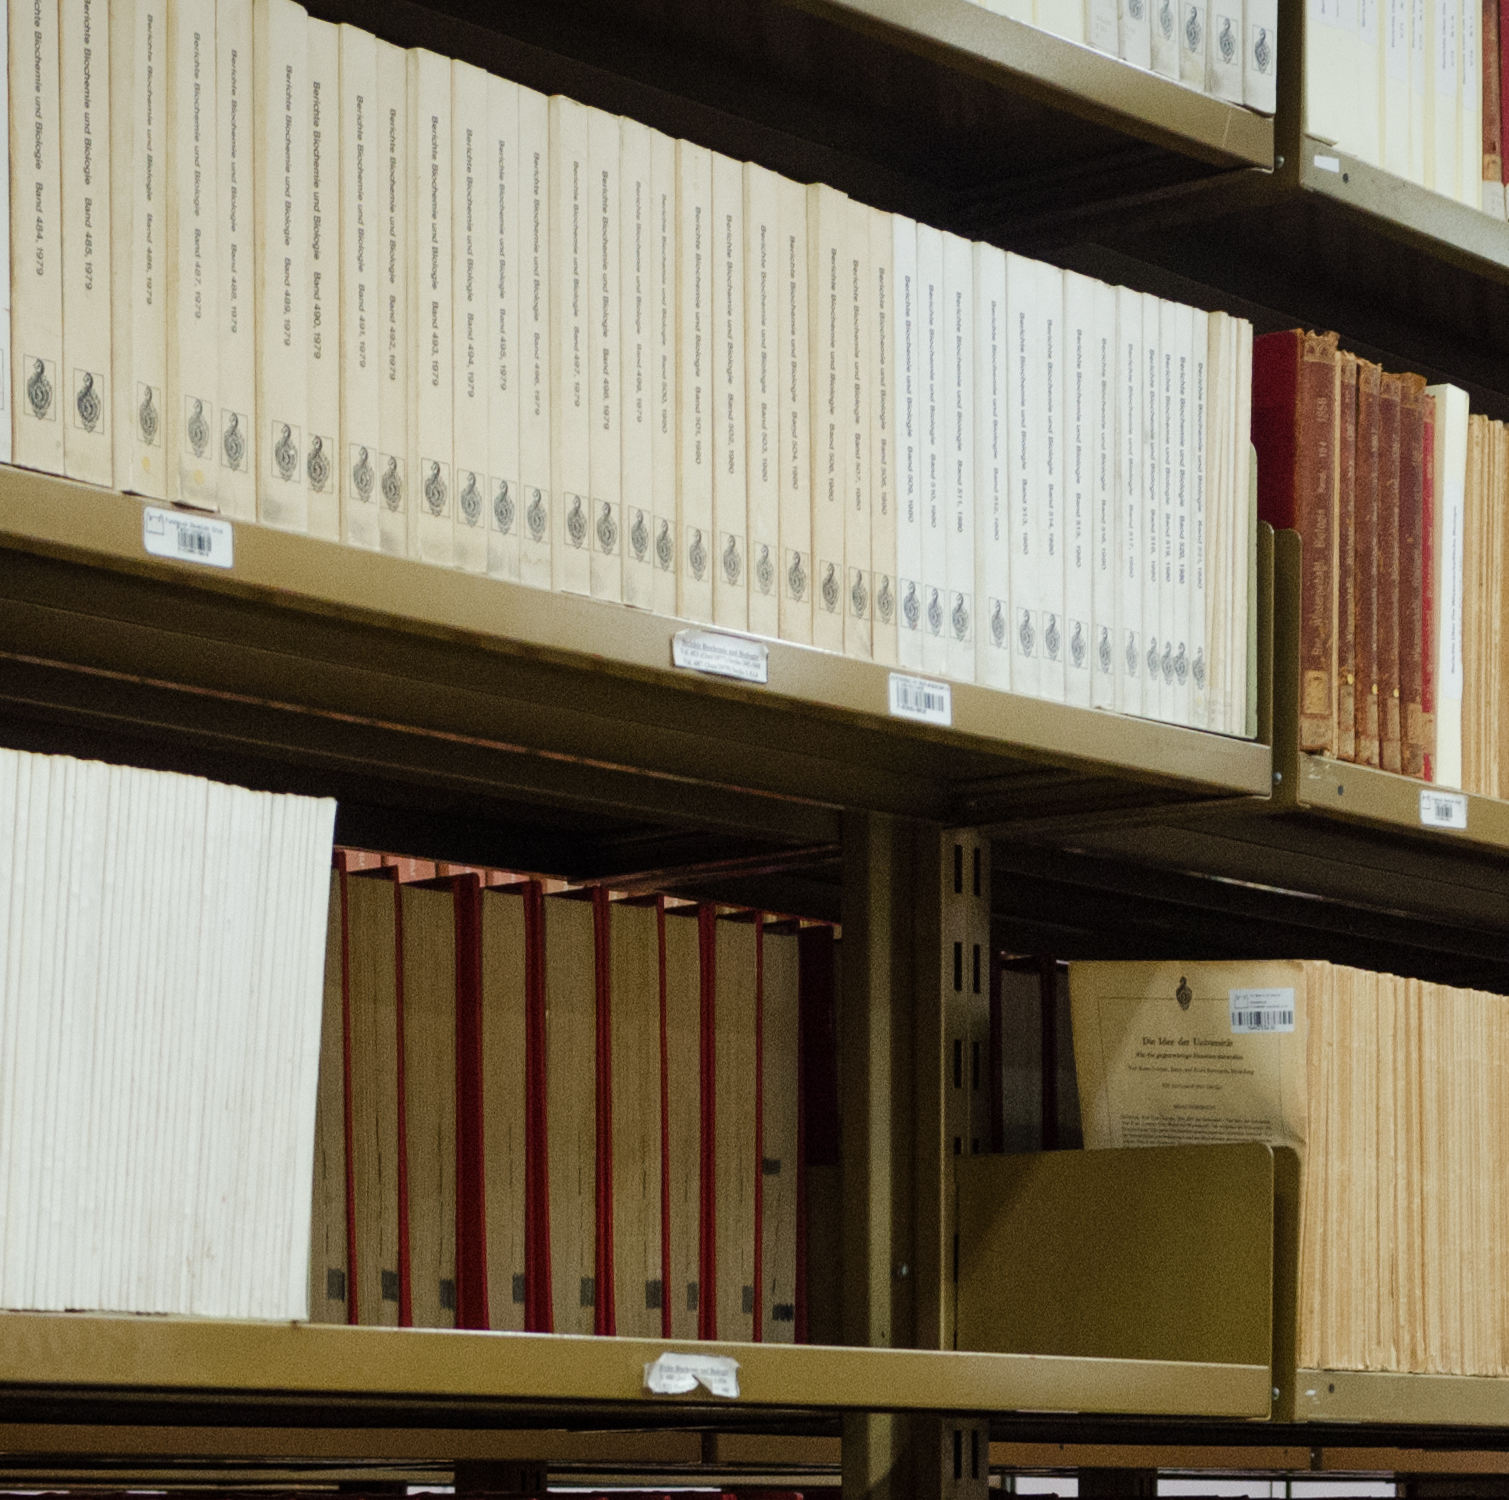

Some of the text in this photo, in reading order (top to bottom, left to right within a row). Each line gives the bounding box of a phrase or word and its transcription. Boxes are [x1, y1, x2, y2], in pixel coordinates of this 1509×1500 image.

[313, 81, 321, 128] Berichte
[83, 138, 92, 185] Biologie
[84, 197, 92, 228] Band
[84, 231, 93, 259] 485,
[313, 216, 321, 261] Biologie
[85, 262, 93, 291] 1979
[314, 303, 322, 329] 490,
